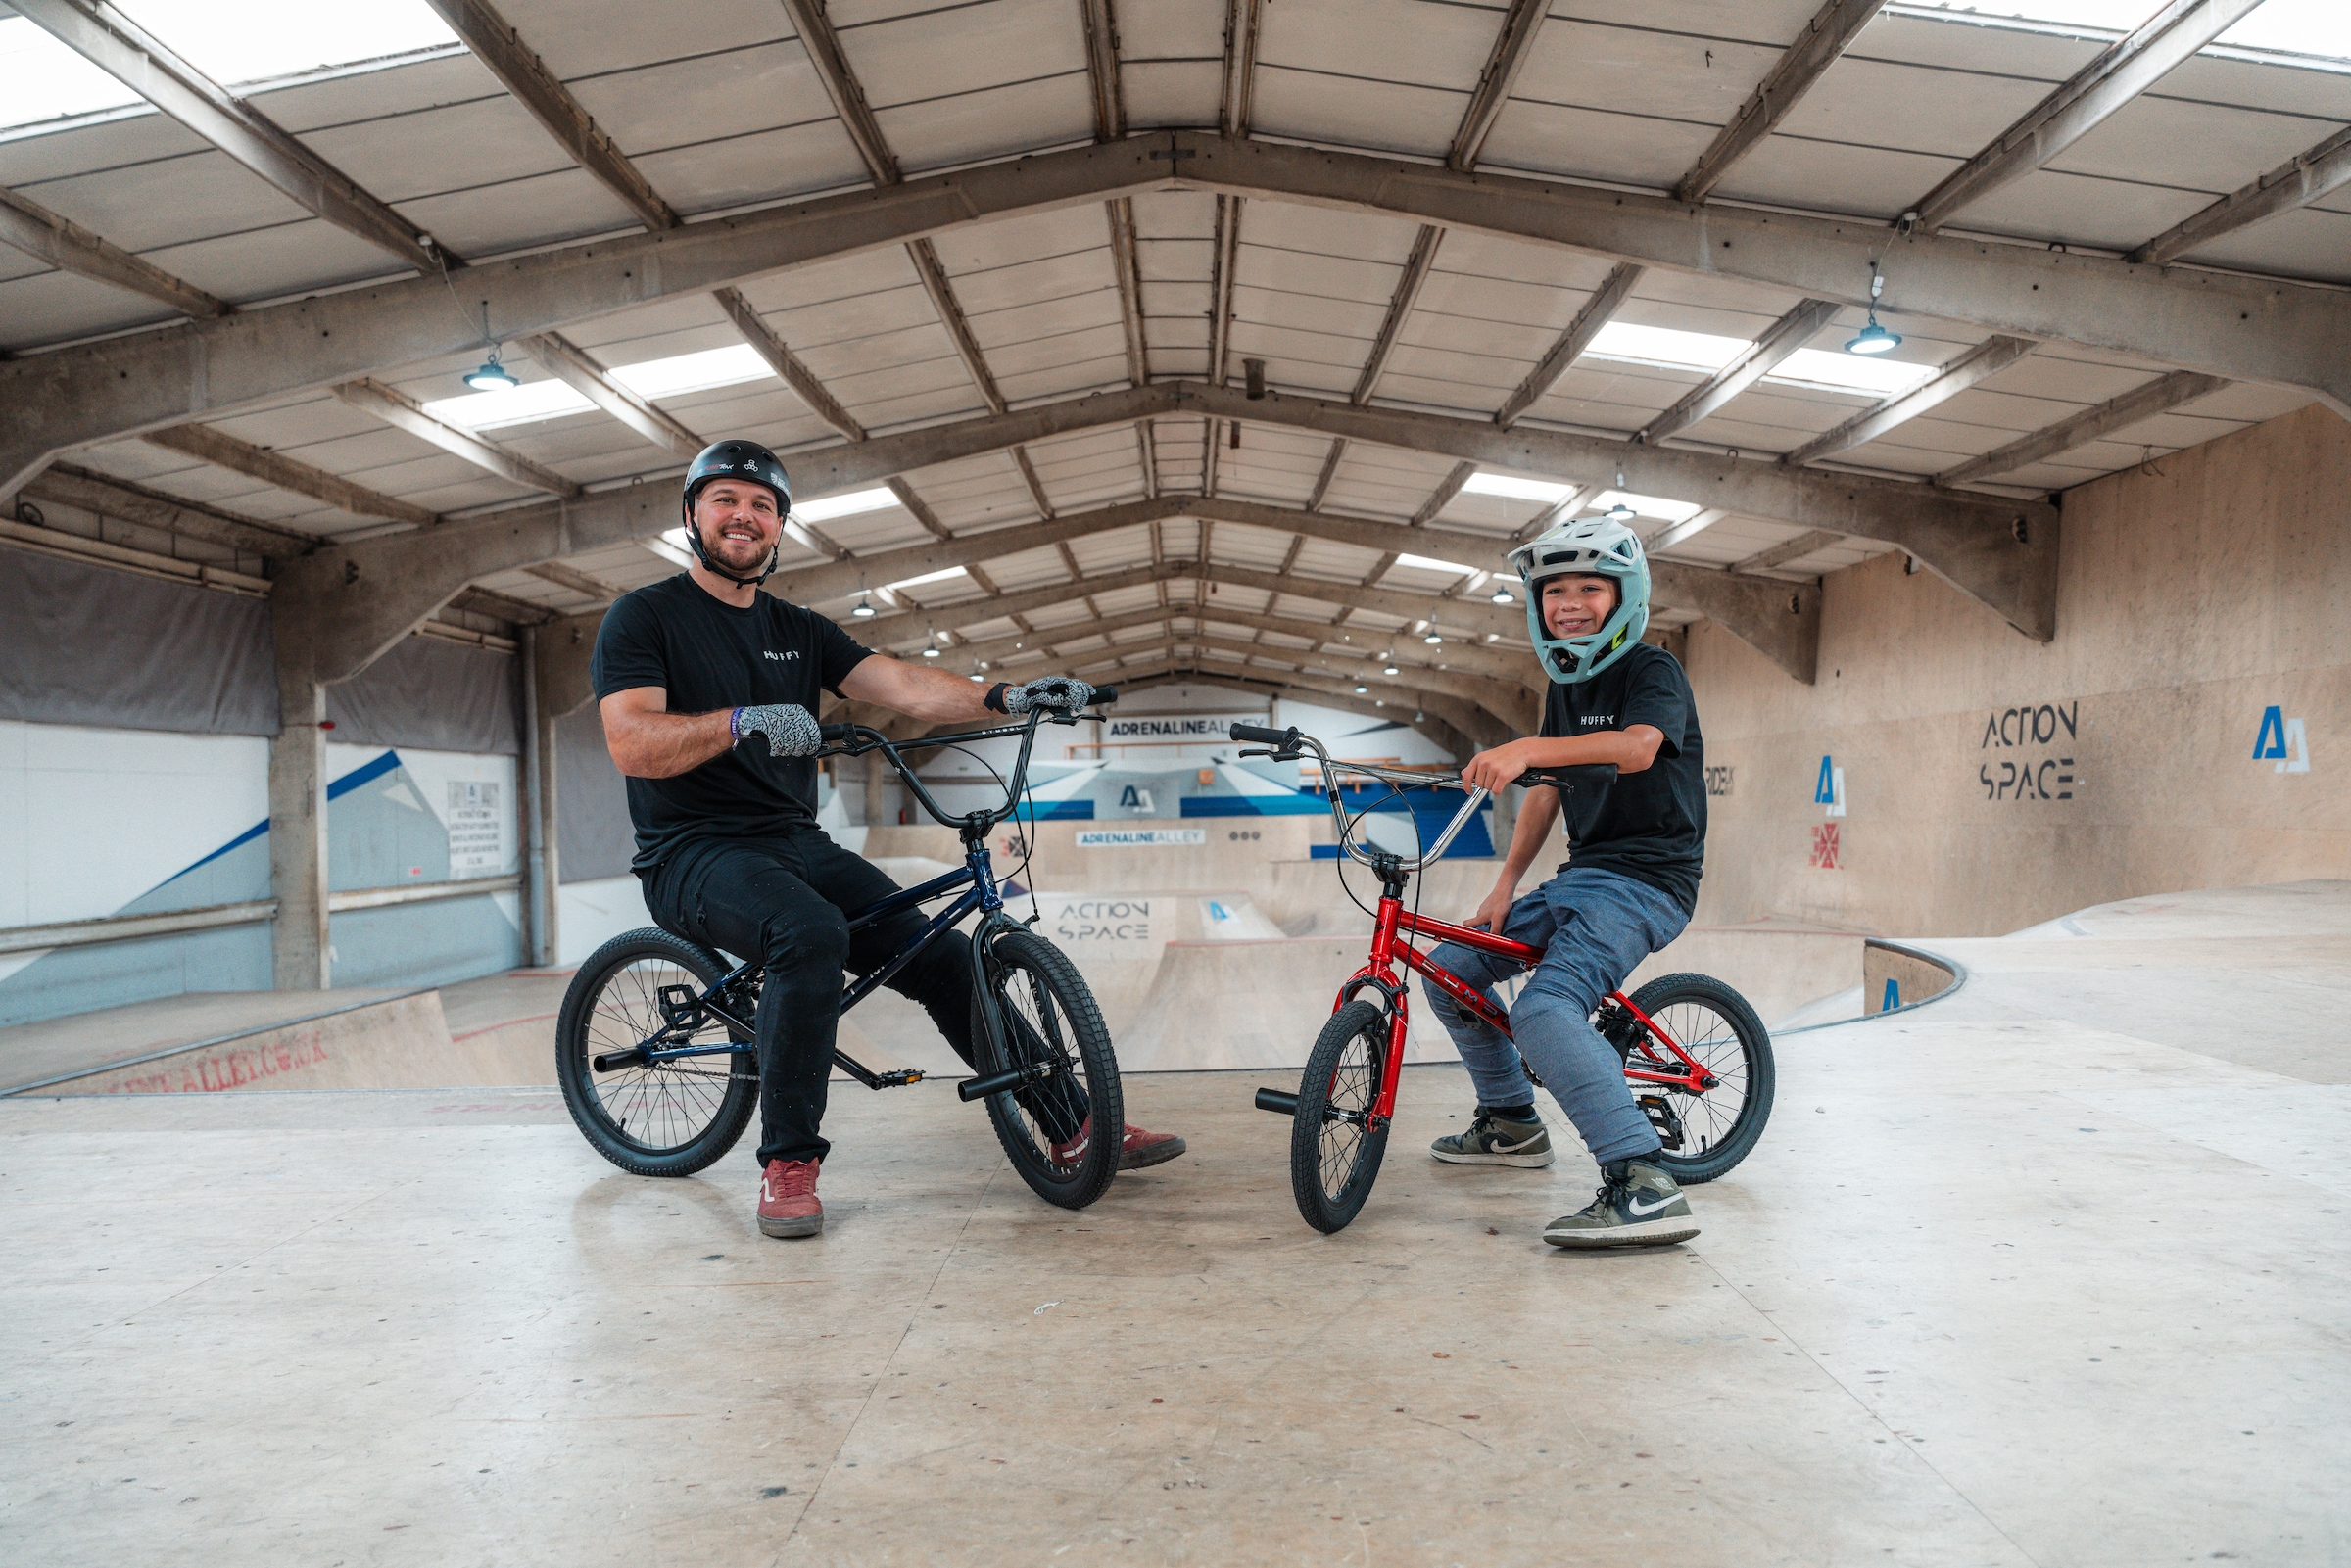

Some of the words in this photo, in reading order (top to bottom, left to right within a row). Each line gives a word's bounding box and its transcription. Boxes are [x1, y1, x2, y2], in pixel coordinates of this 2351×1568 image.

[763, 650, 800, 661] HUFFY
[1007, 698, 1018, 715] FIST
[1580, 715, 1615, 726] HUFFY
[1981, 700, 2078, 749] ACTION
[1980, 758, 2074, 800] SPACE
[1059, 901, 1149, 920] ACTION
[1058, 924, 1149, 940] SPACE
